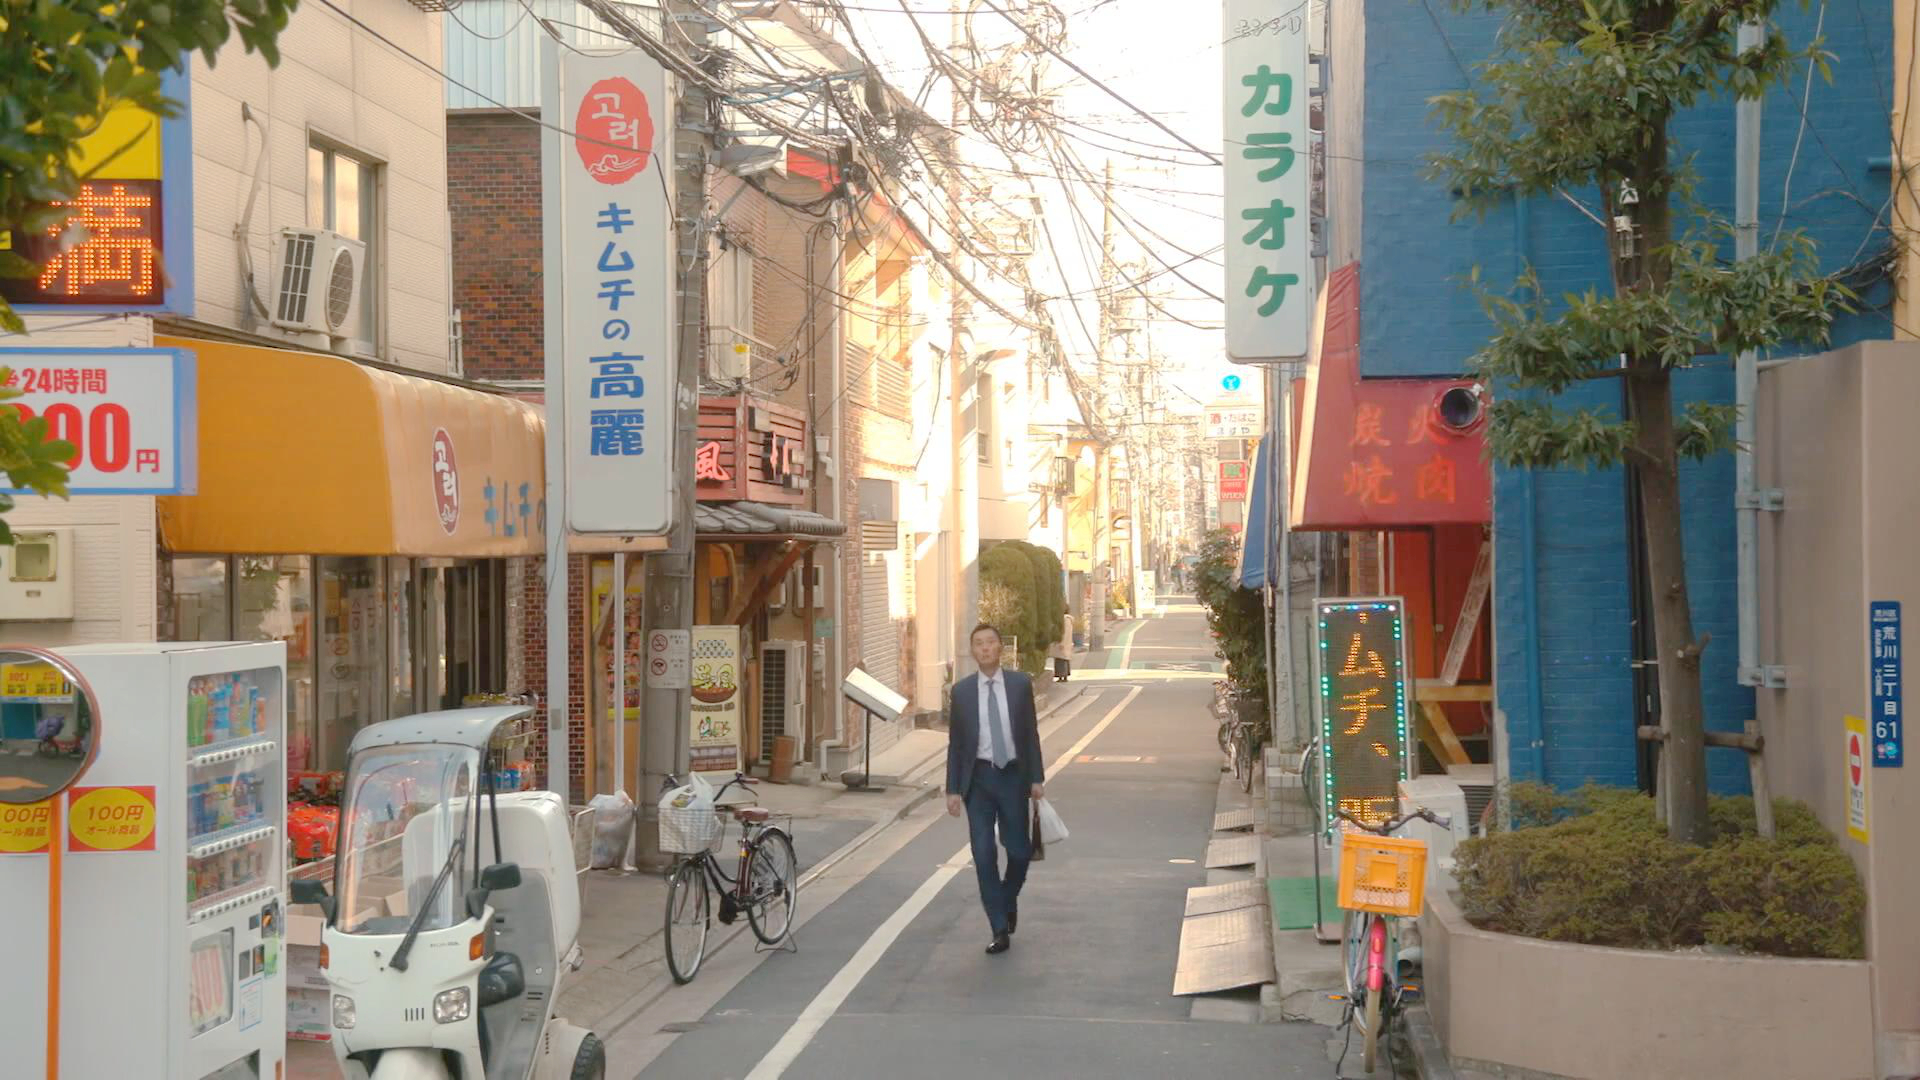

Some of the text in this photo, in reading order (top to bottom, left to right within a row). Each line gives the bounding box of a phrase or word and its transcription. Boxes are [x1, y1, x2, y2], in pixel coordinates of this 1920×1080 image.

[592, 92, 639, 149] 고려
[1241, 64, 1299, 318] カラオケ
[39, 184, 153, 296] 満
[589, 202, 645, 456] キムチの高麗
[0, 402, 160, 474] 00円
[434, 440, 458, 506] 고려
[1882, 627, 1897, 715] 荒川三丁目
[1876, 721, 1897, 738] 61
[0, 826, 47, 838] ール商品
[88, 805, 144, 820] 100円
